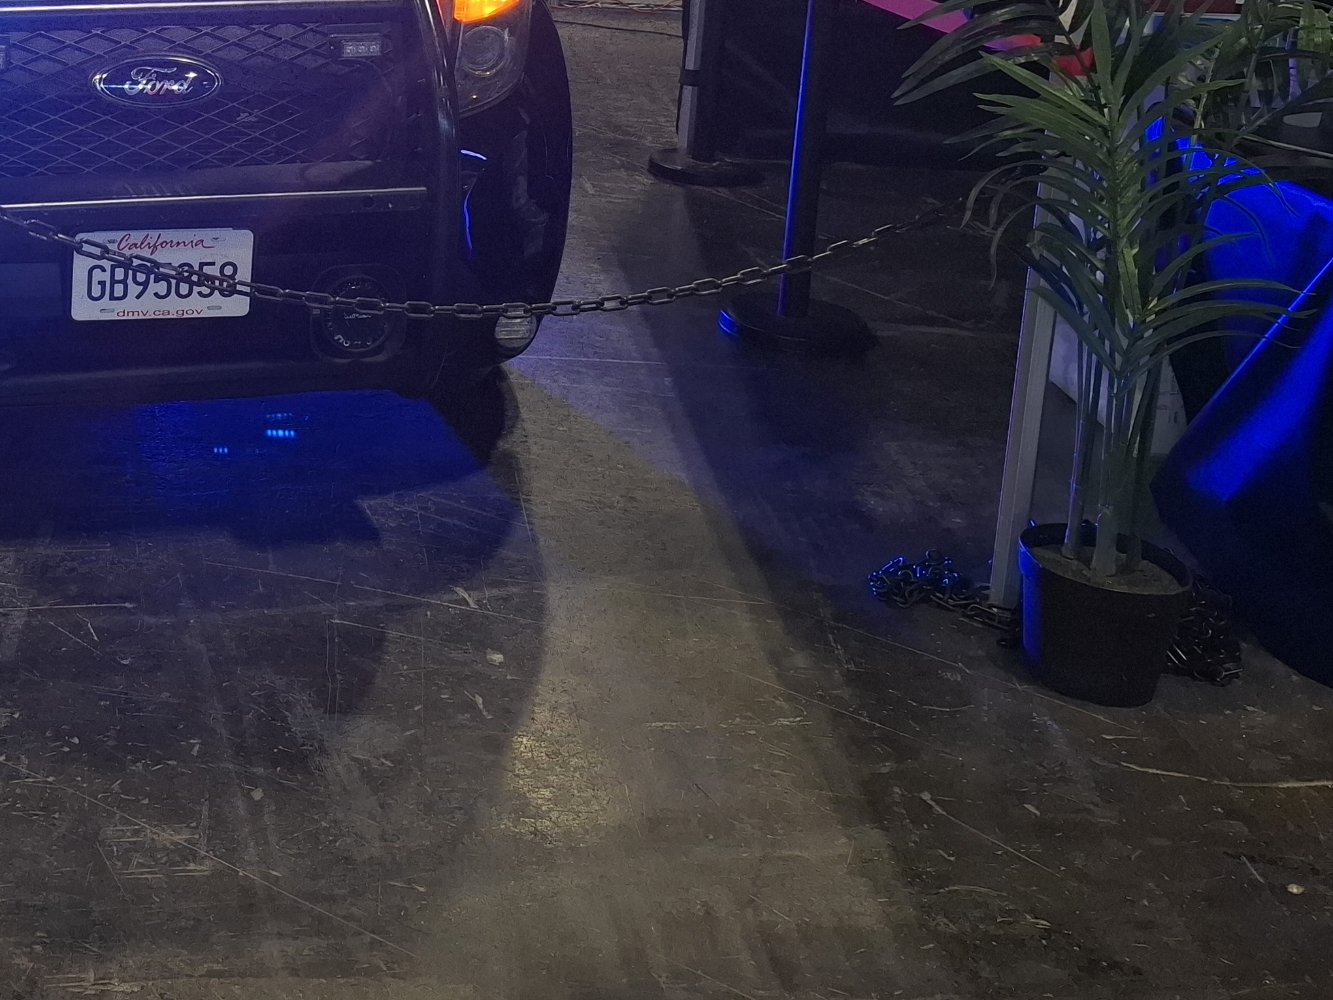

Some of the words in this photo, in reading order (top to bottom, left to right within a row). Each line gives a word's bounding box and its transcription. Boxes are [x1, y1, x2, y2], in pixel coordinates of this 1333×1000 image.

[124, 66, 197, 95] Ford
[117, 233, 214, 256] California
[116, 308, 204, 318] dmv.ca.gov
